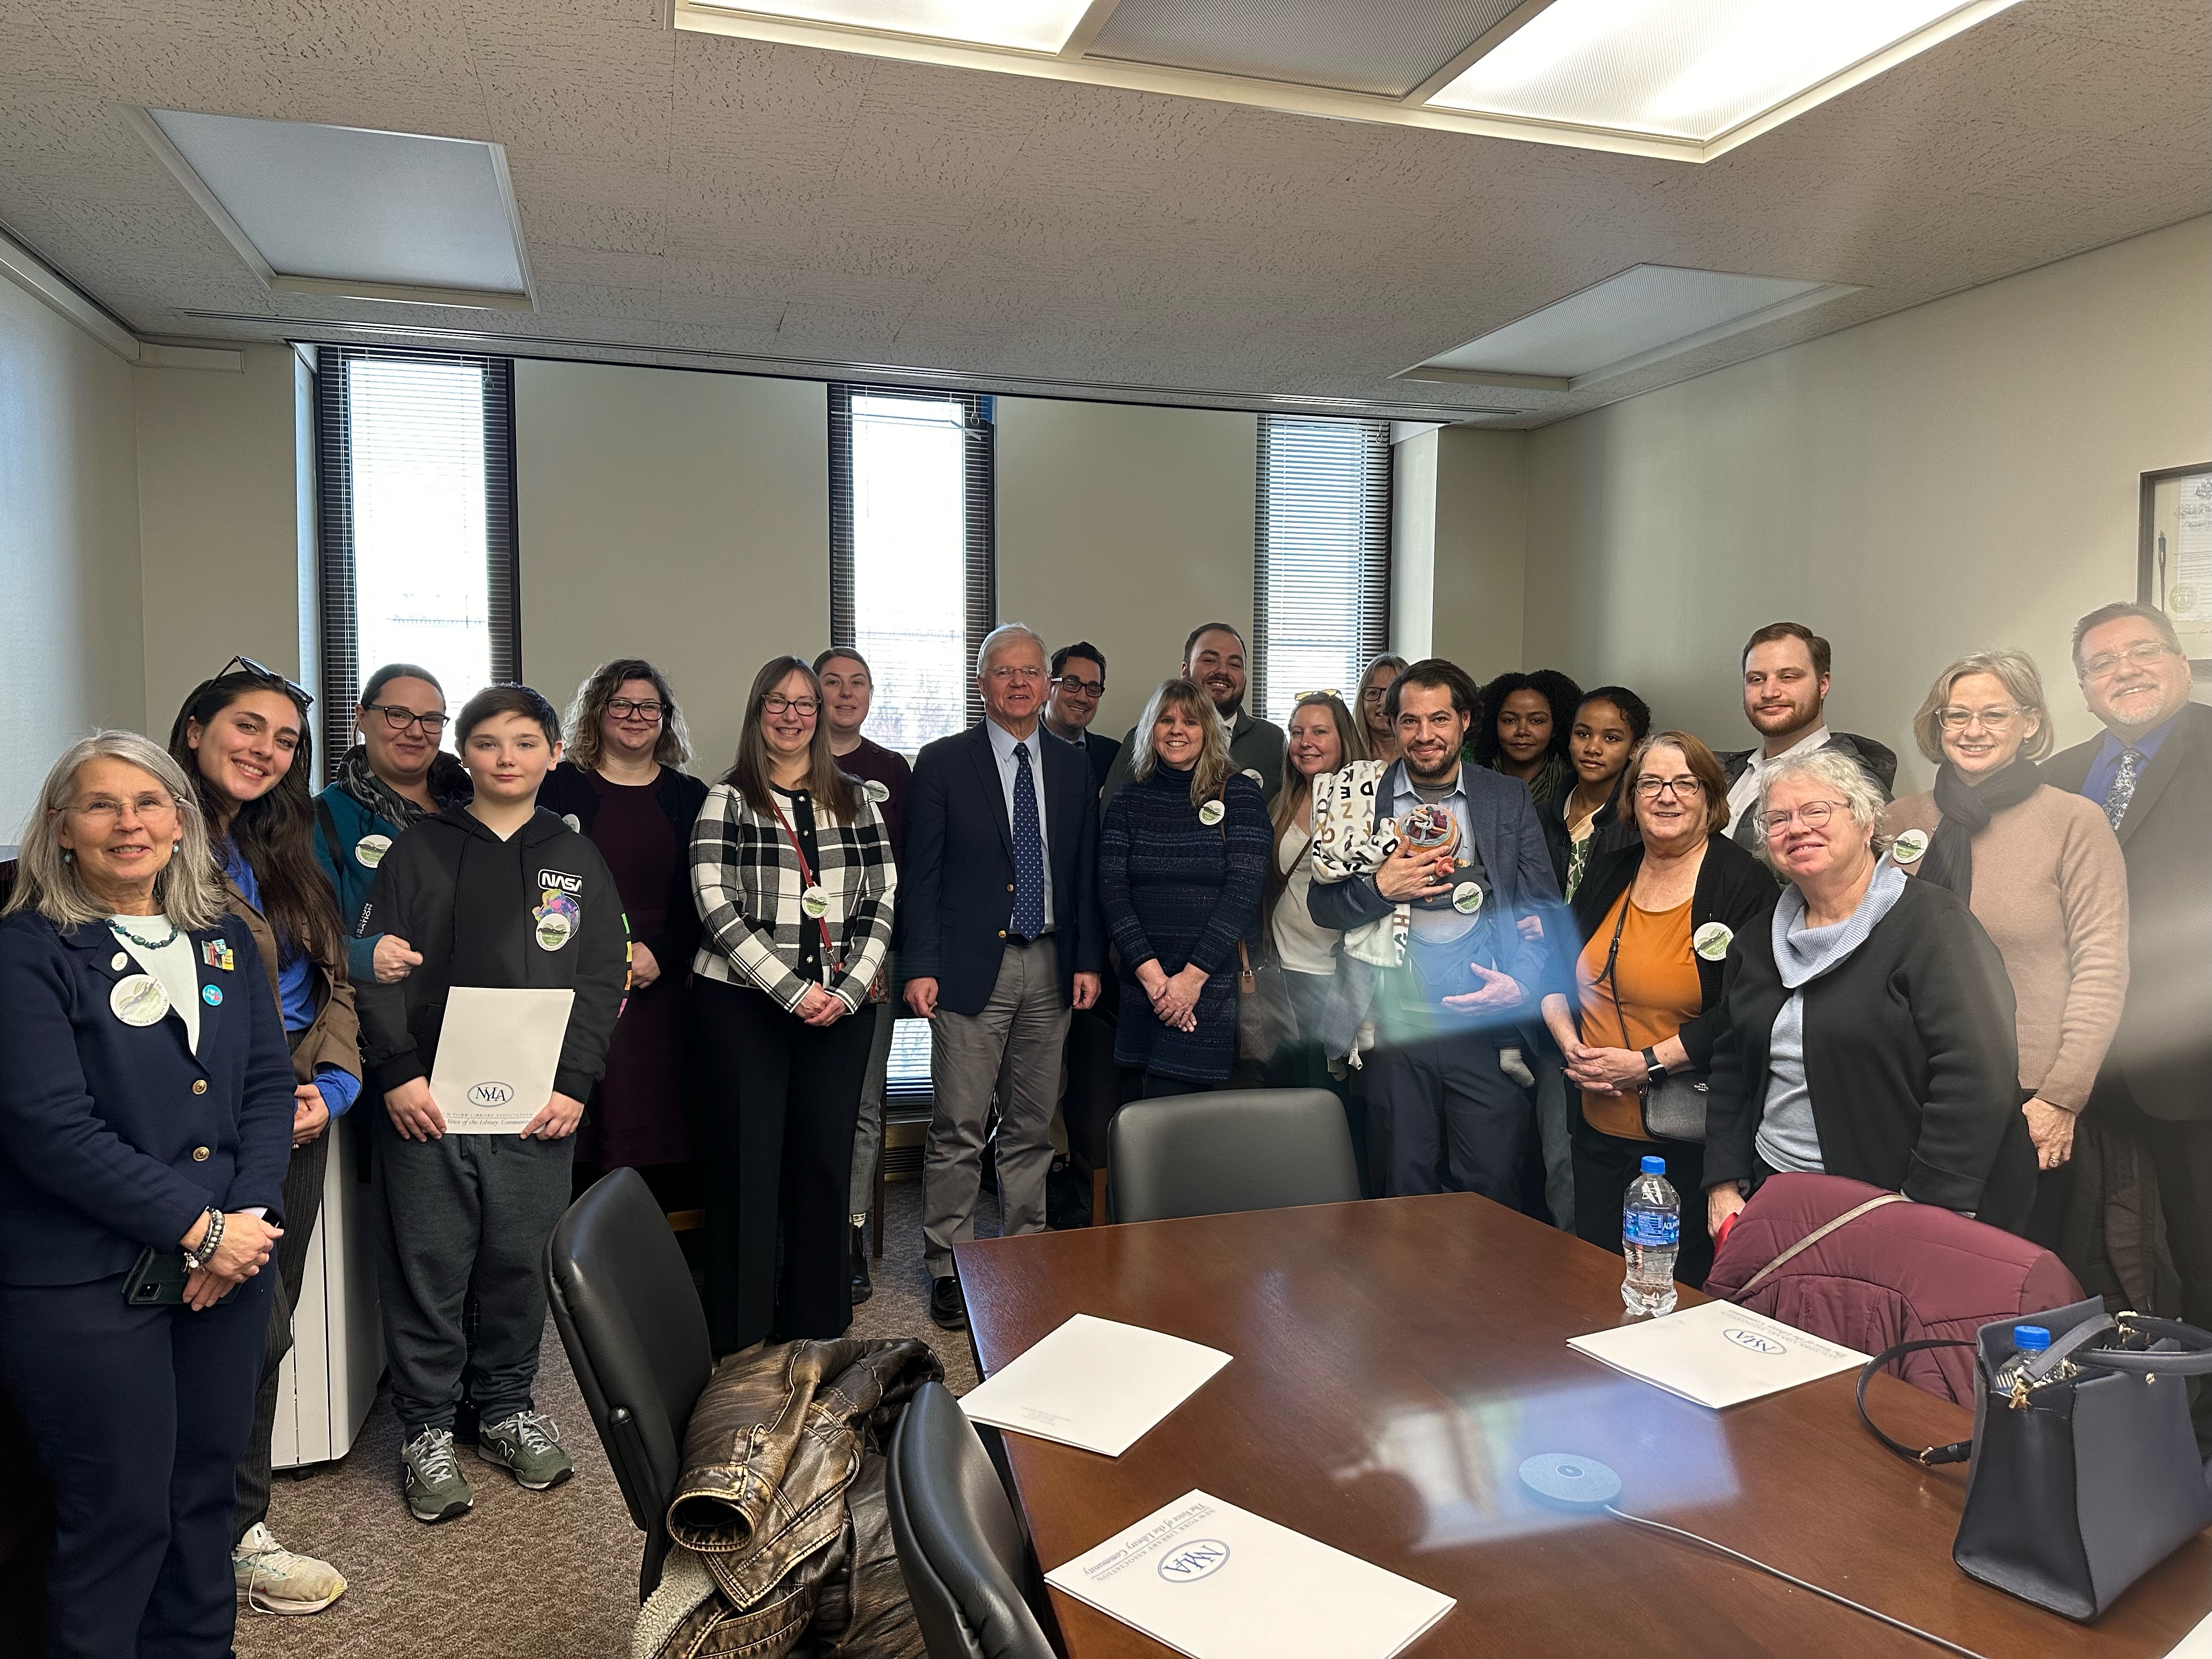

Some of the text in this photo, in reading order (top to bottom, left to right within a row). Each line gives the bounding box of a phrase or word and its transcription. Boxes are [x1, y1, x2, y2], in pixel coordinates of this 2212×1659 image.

[475, 1087, 506, 1101] NYLA
[1126, 1532, 1154, 1550] Library
[1083, 1549, 1128, 1576] Community
[1163, 1544, 1225, 1574] NYLA
